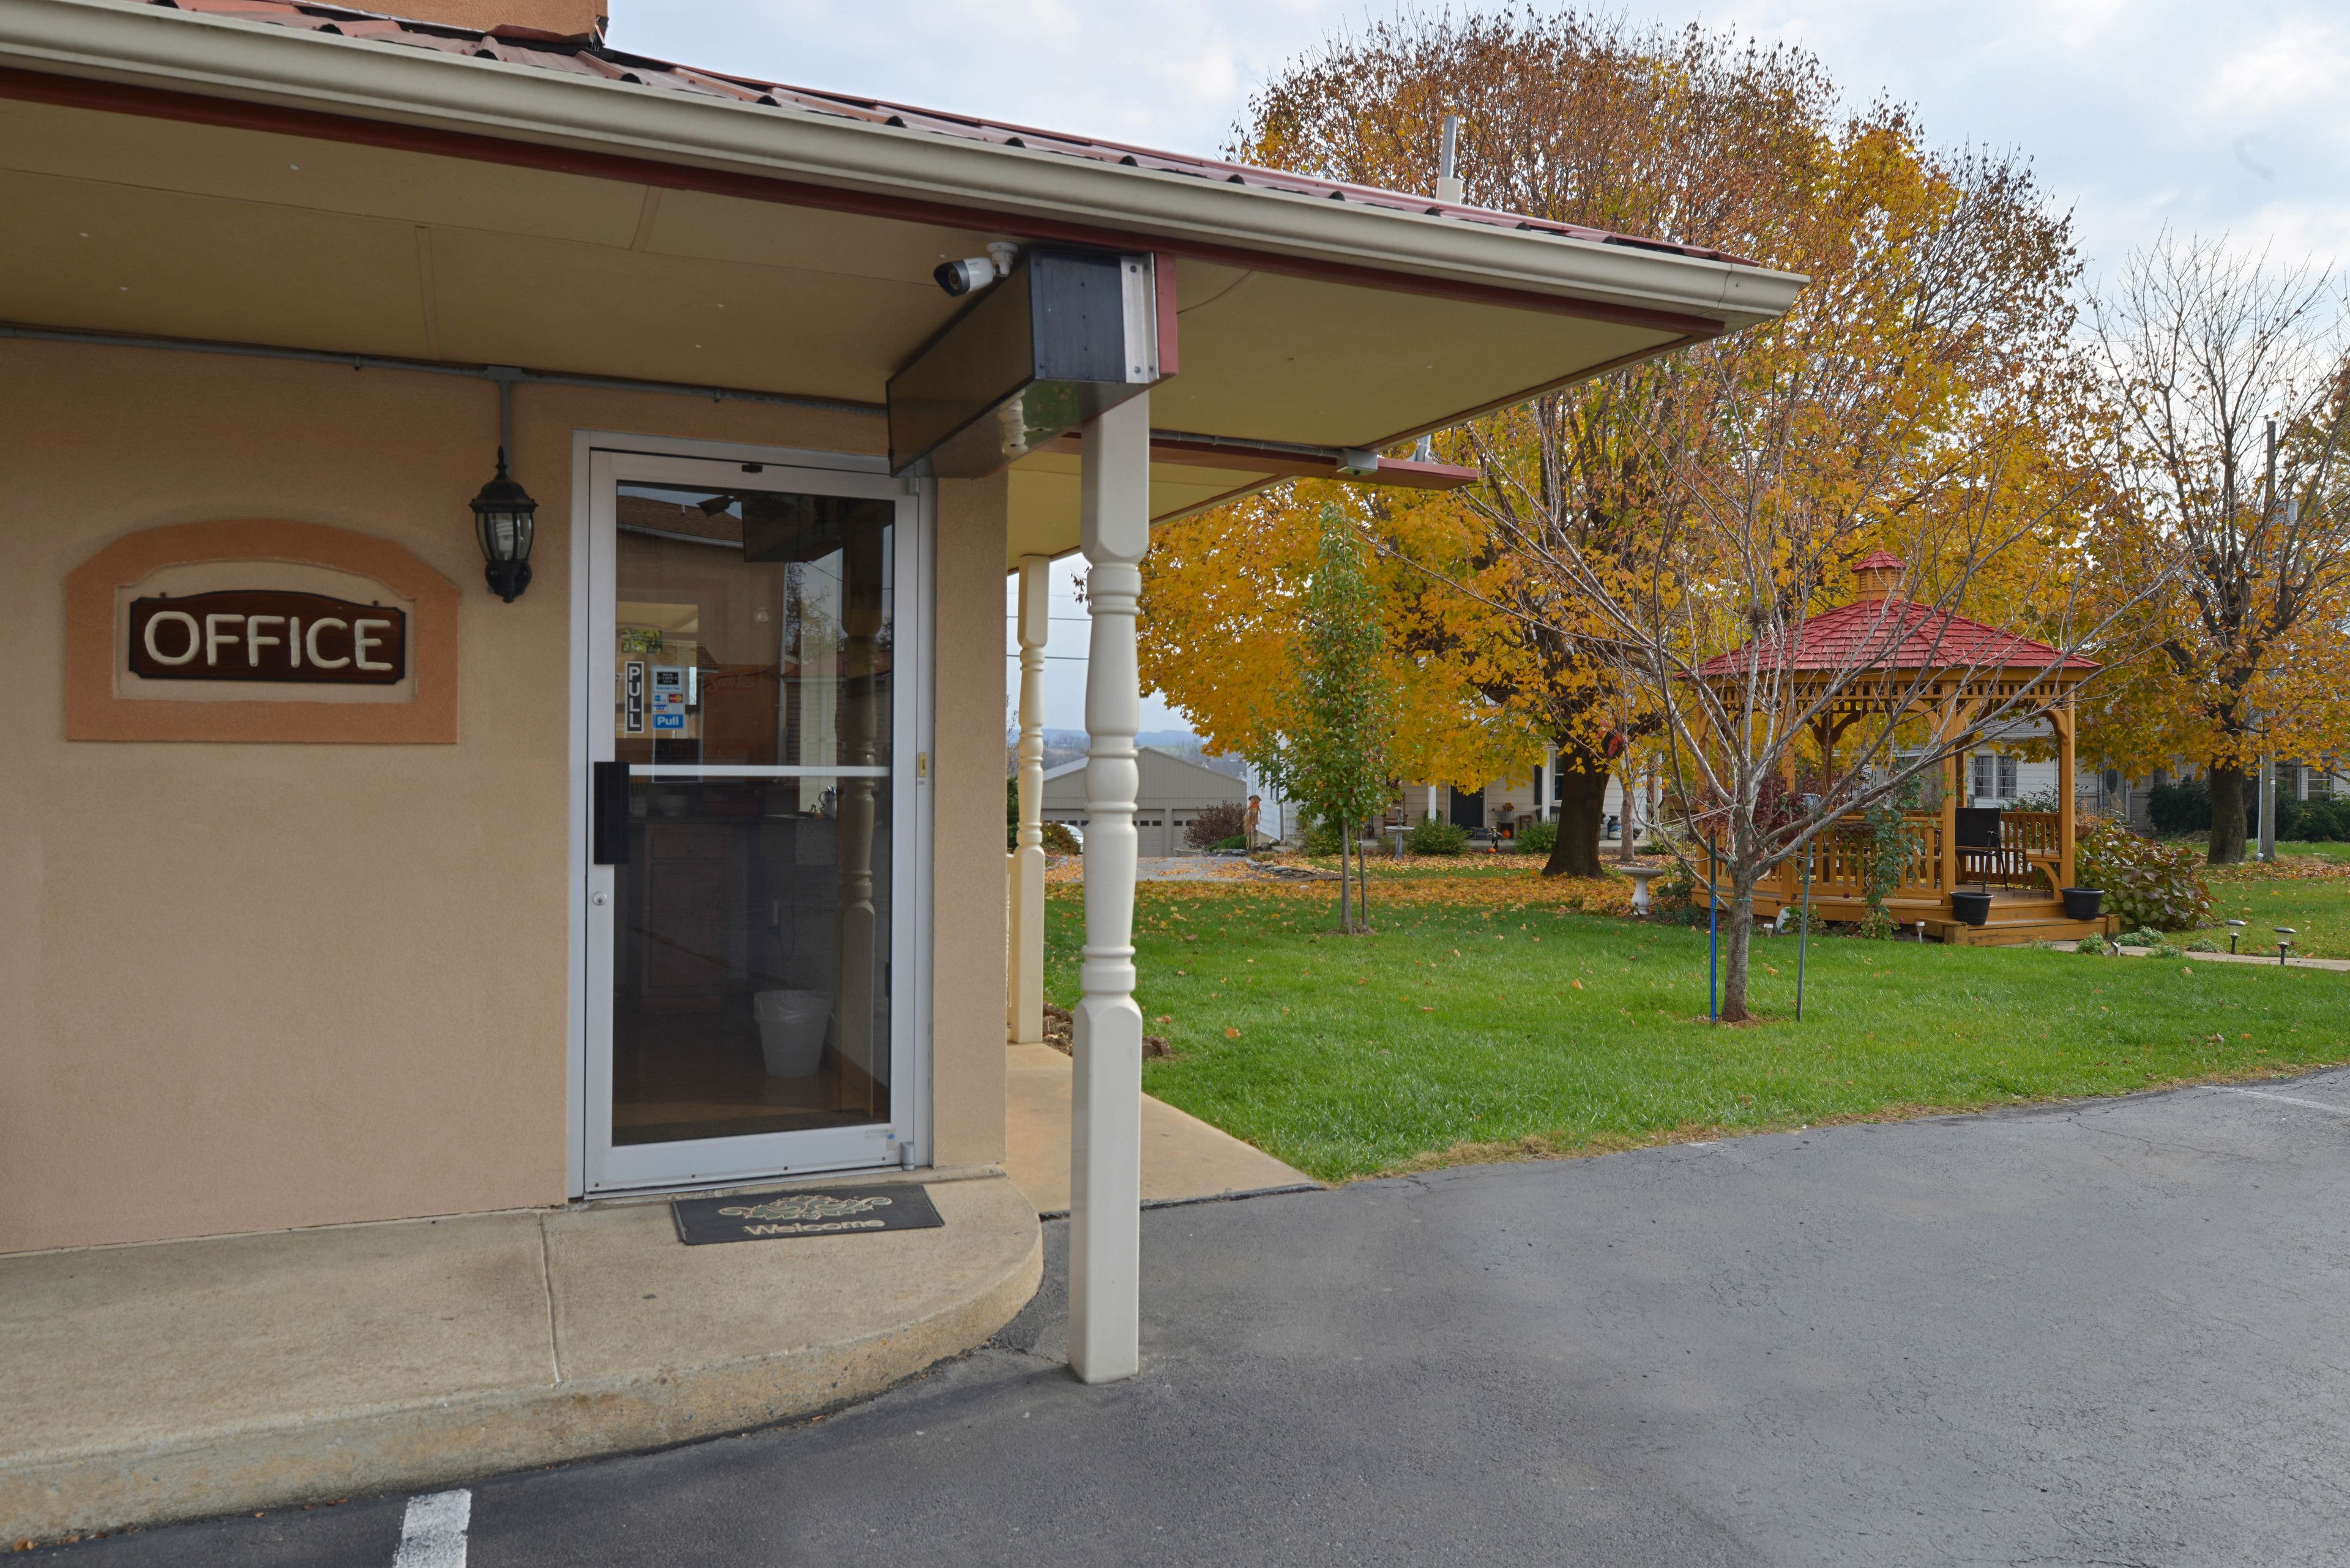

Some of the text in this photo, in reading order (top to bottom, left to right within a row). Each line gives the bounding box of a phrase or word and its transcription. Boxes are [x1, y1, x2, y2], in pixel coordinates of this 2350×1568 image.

[144, 611, 393, 671] OFFICE
[629, 666, 641, 728] PULL
[657, 716, 679, 725] Pull
[743, 1220, 886, 1235] Welcome
